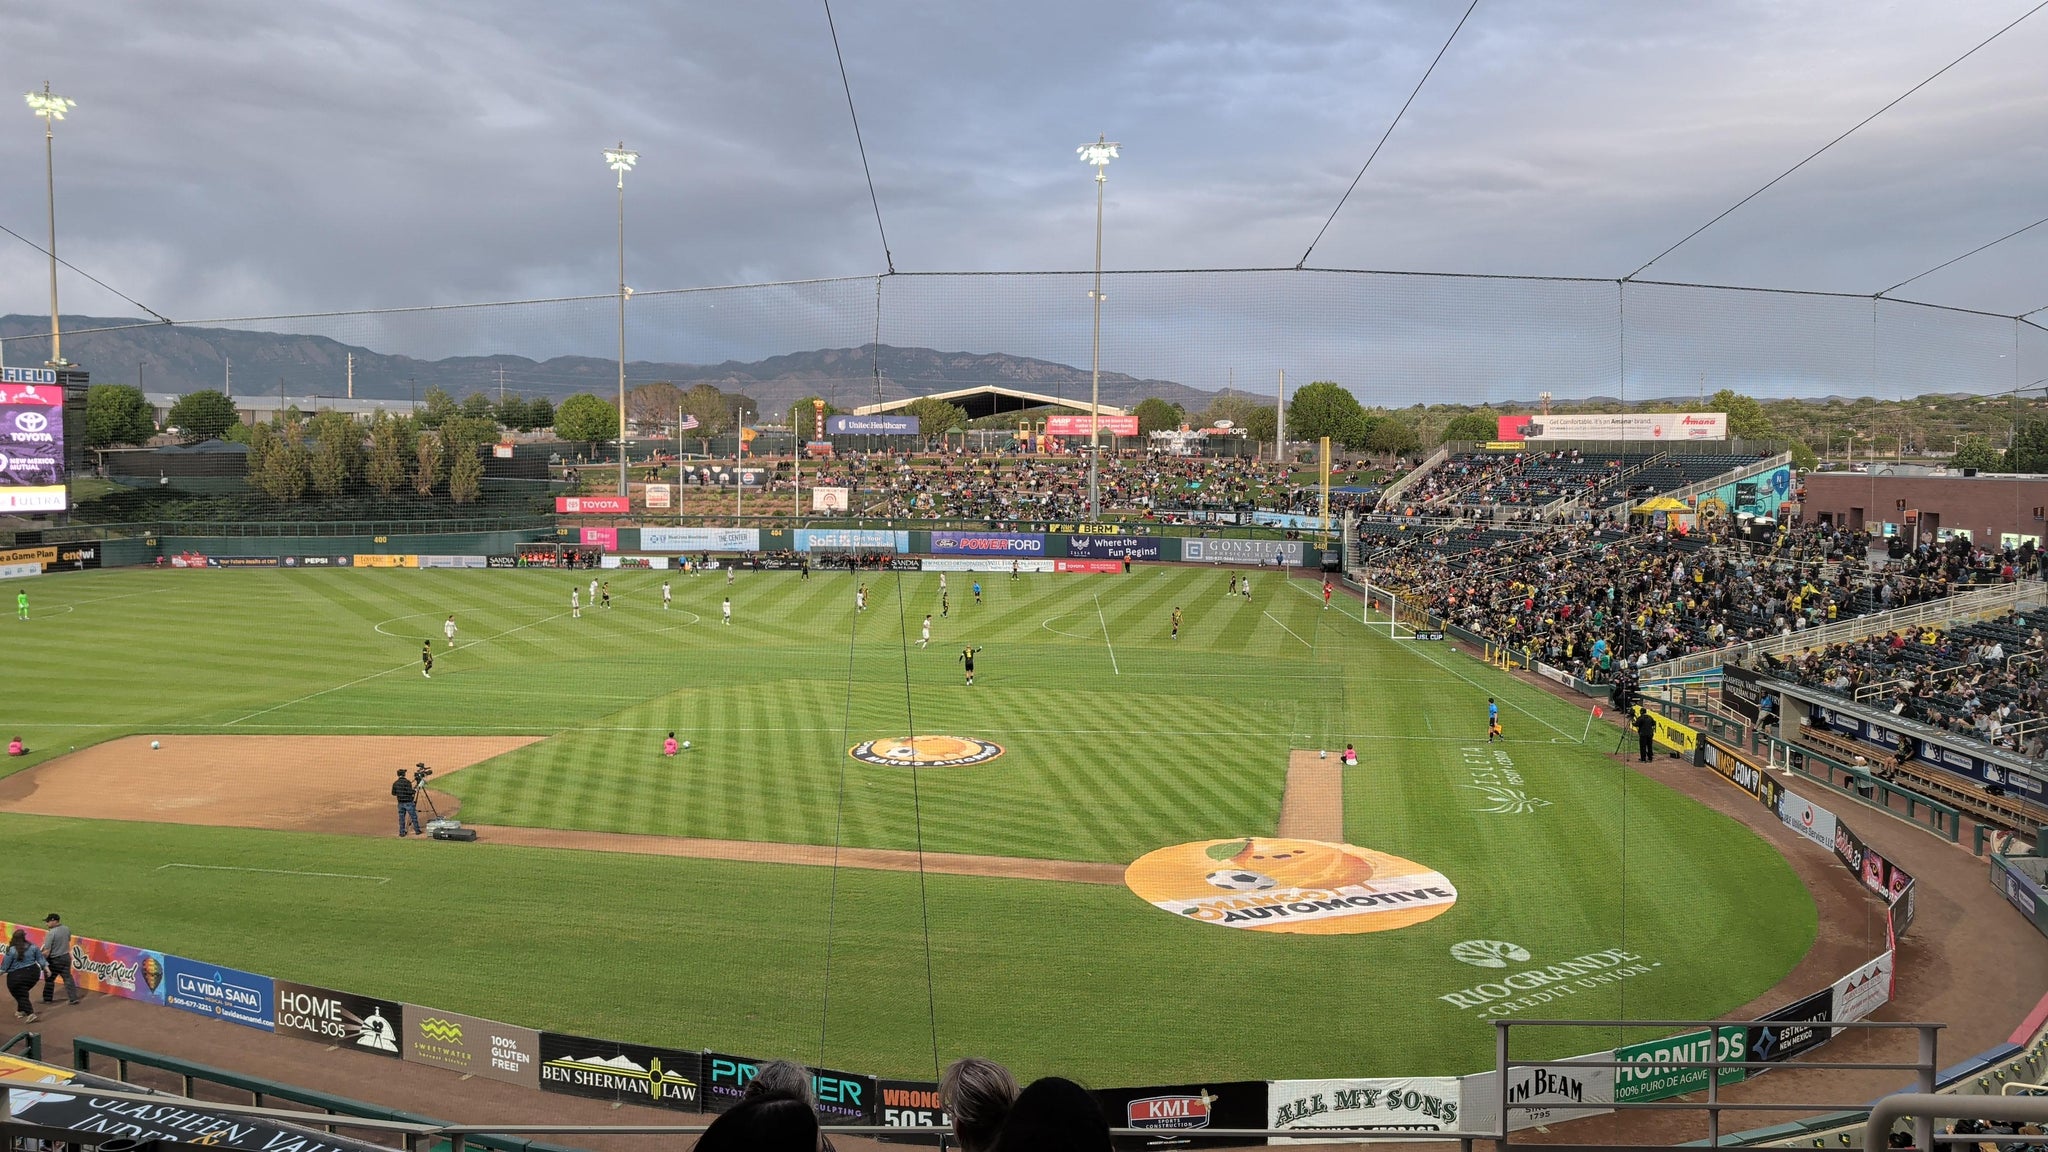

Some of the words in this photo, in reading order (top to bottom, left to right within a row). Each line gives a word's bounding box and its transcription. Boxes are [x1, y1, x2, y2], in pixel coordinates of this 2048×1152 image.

[3, 367, 56, 384] FIELD
[1681, 416, 1716, 425] Amana
[10, 432, 53, 441] TOYOTA
[19, 496, 61, 505] ULTRA
[582, 500, 619, 509] TOYOTA
[1083, 525, 1113, 533] BERM
[808, 534, 836, 546] SoFi
[959, 539, 1041, 551] POWERFORD
[1094, 539, 1121, 547] Where
[1123, 538, 1137, 546] the
[1209, 541, 1297, 553] GONSTEAD
[12, 551, 35, 561] Game
[37, 550, 54, 558] Plan
[1108, 548, 1124, 557] Fun
[1126, 547, 1157, 557] Begins!
[891, 559, 919, 567] SANDIA
[1667, 726, 1684, 746] PUMA
[1223, 886, 1453, 923] AUTOMOTIVE
[180, 977, 195, 991] LA
[197, 981, 224, 998] VIDA
[225, 989, 258, 1007] SANA
[1488, 985, 1578, 1016] CREDIT
[1576, 963, 1652, 990] UNION
[280, 990, 343, 1021] HOME
[222, 1007, 275, 1027] lavidasanamd.com
[278, 1012, 319, 1033] LOCAL
[320, 1022, 346, 1038] 505
[491, 1036, 517, 1050] 100%
[1780, 1038, 1792, 1050] NEW
[1792, 1030, 1813, 1046] MEXICO
[414, 1042, 473, 1060] SWEETWATER
[491, 1047, 530, 1064] GLUTEN
[491, 1058, 519, 1072] FREE!
[542, 1065, 571, 1083] BEN
[574, 1069, 650, 1095] SHERMAN
[662, 1084, 697, 1102] LAW
[712, 1058, 863, 1106] PRIER
[1509, 1078, 1530, 1103] IM
[1534, 1068, 1583, 1103] BEAM
[1615, 1086, 1639, 1099] 100%
[1640, 1080, 1665, 1094] PURO
[1667, 1076, 1679, 1088] DE
[1679, 1070, 1708, 1085] AGAVE
[883, 1088, 941, 1110] WRONG
[814, 1103, 863, 1118] CULPTING
[1149, 1099, 1190, 1118] KMI
[1275, 1093, 1328, 1128] ALL
[1333, 1089, 1382, 1111] MY
[1387, 1088, 1458, 1125] SONS
[1529, 1110, 1551, 1121] 1795
